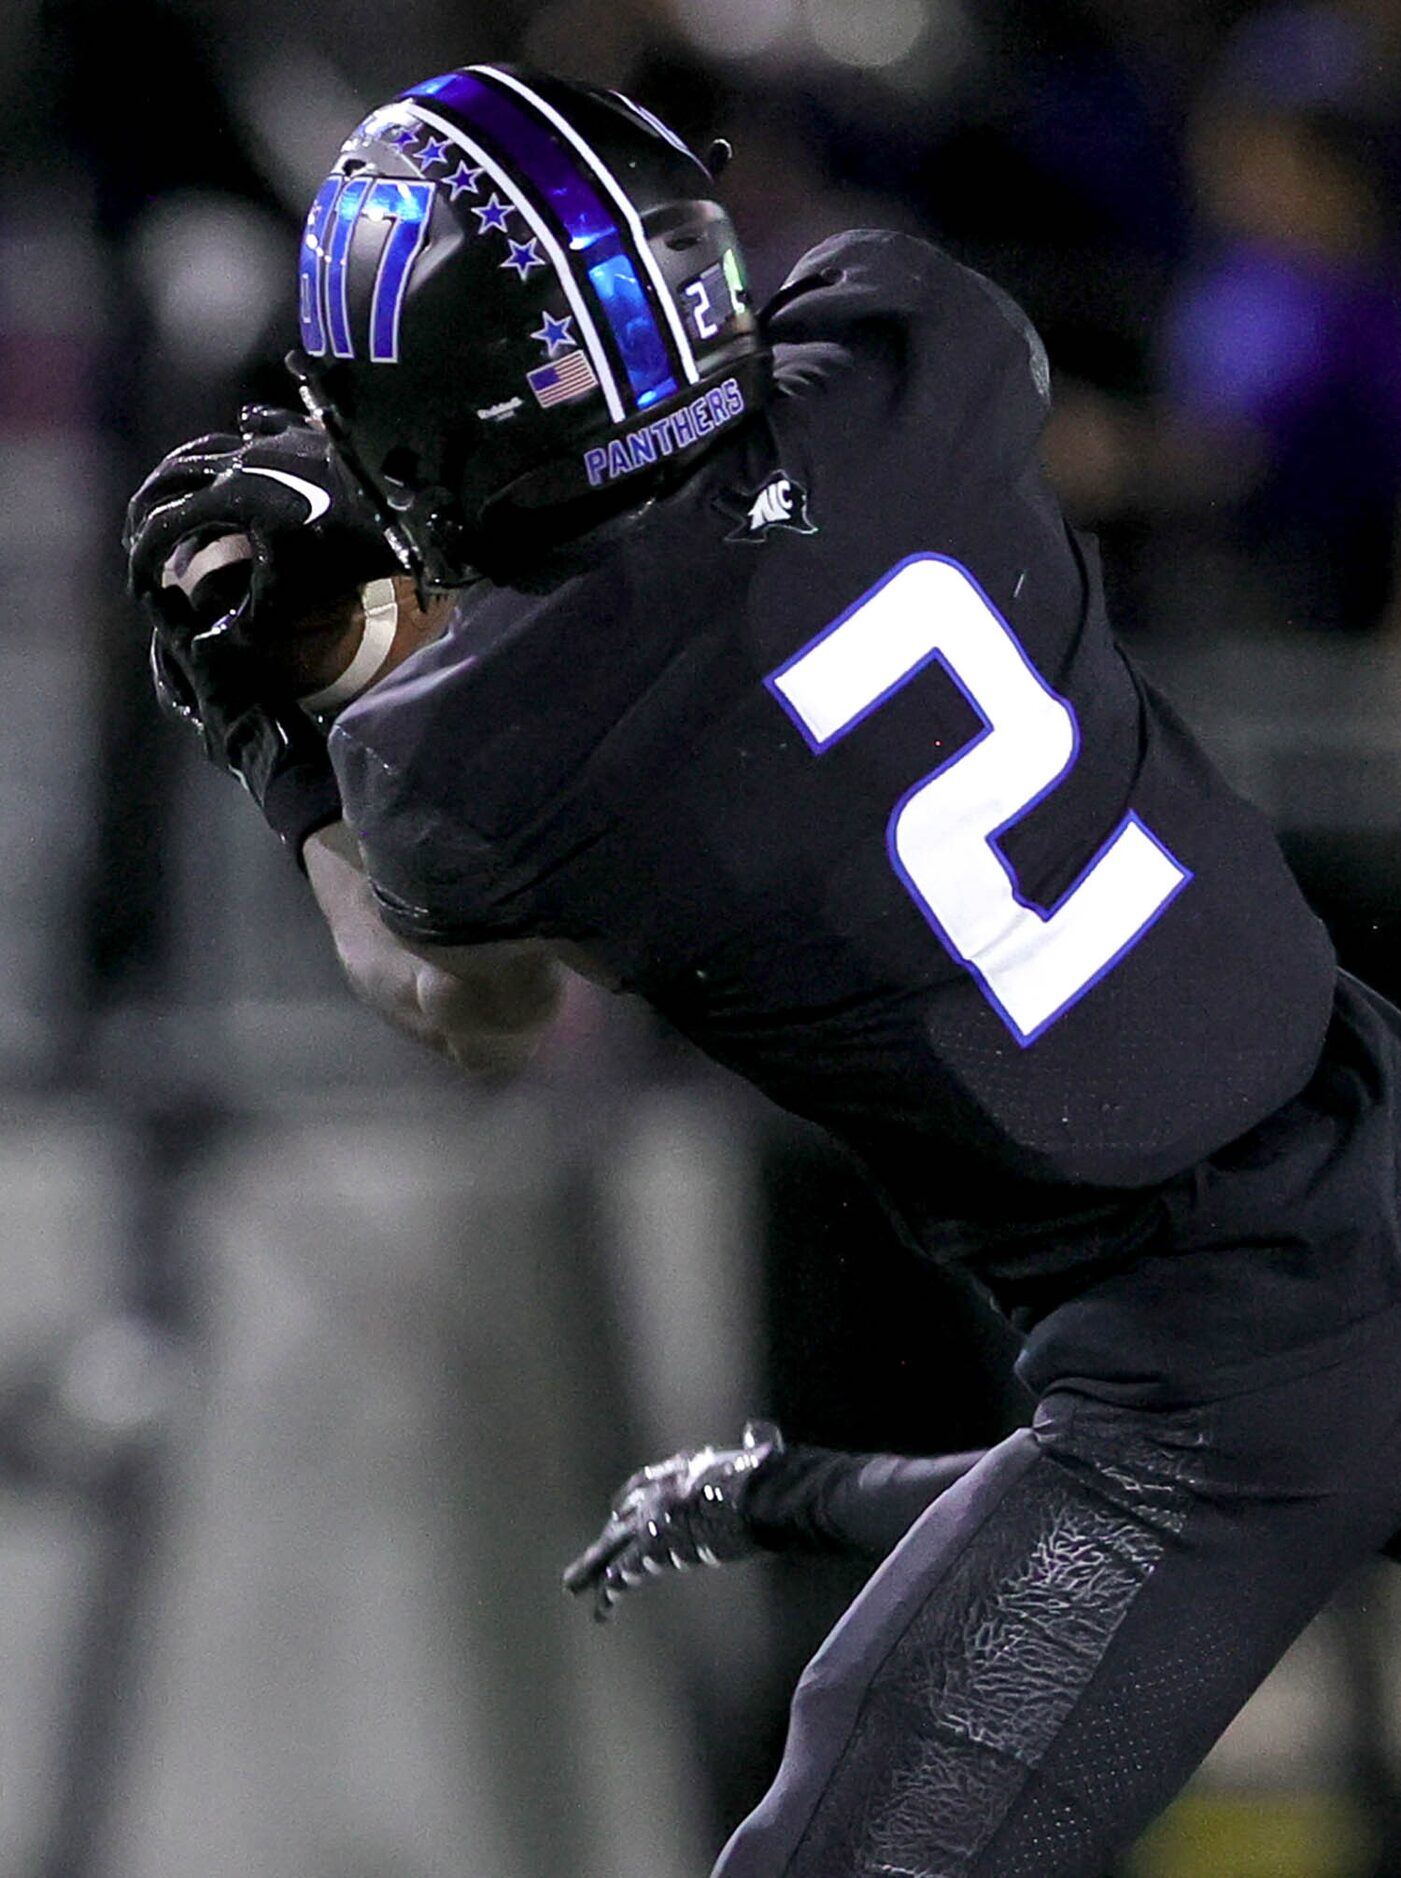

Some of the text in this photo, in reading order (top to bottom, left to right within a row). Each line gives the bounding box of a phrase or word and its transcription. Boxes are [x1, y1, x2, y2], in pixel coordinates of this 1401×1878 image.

[685, 280, 718, 339] 2
[583, 377, 744, 487] PANTHERS
[763, 551, 1194, 1048] 2
